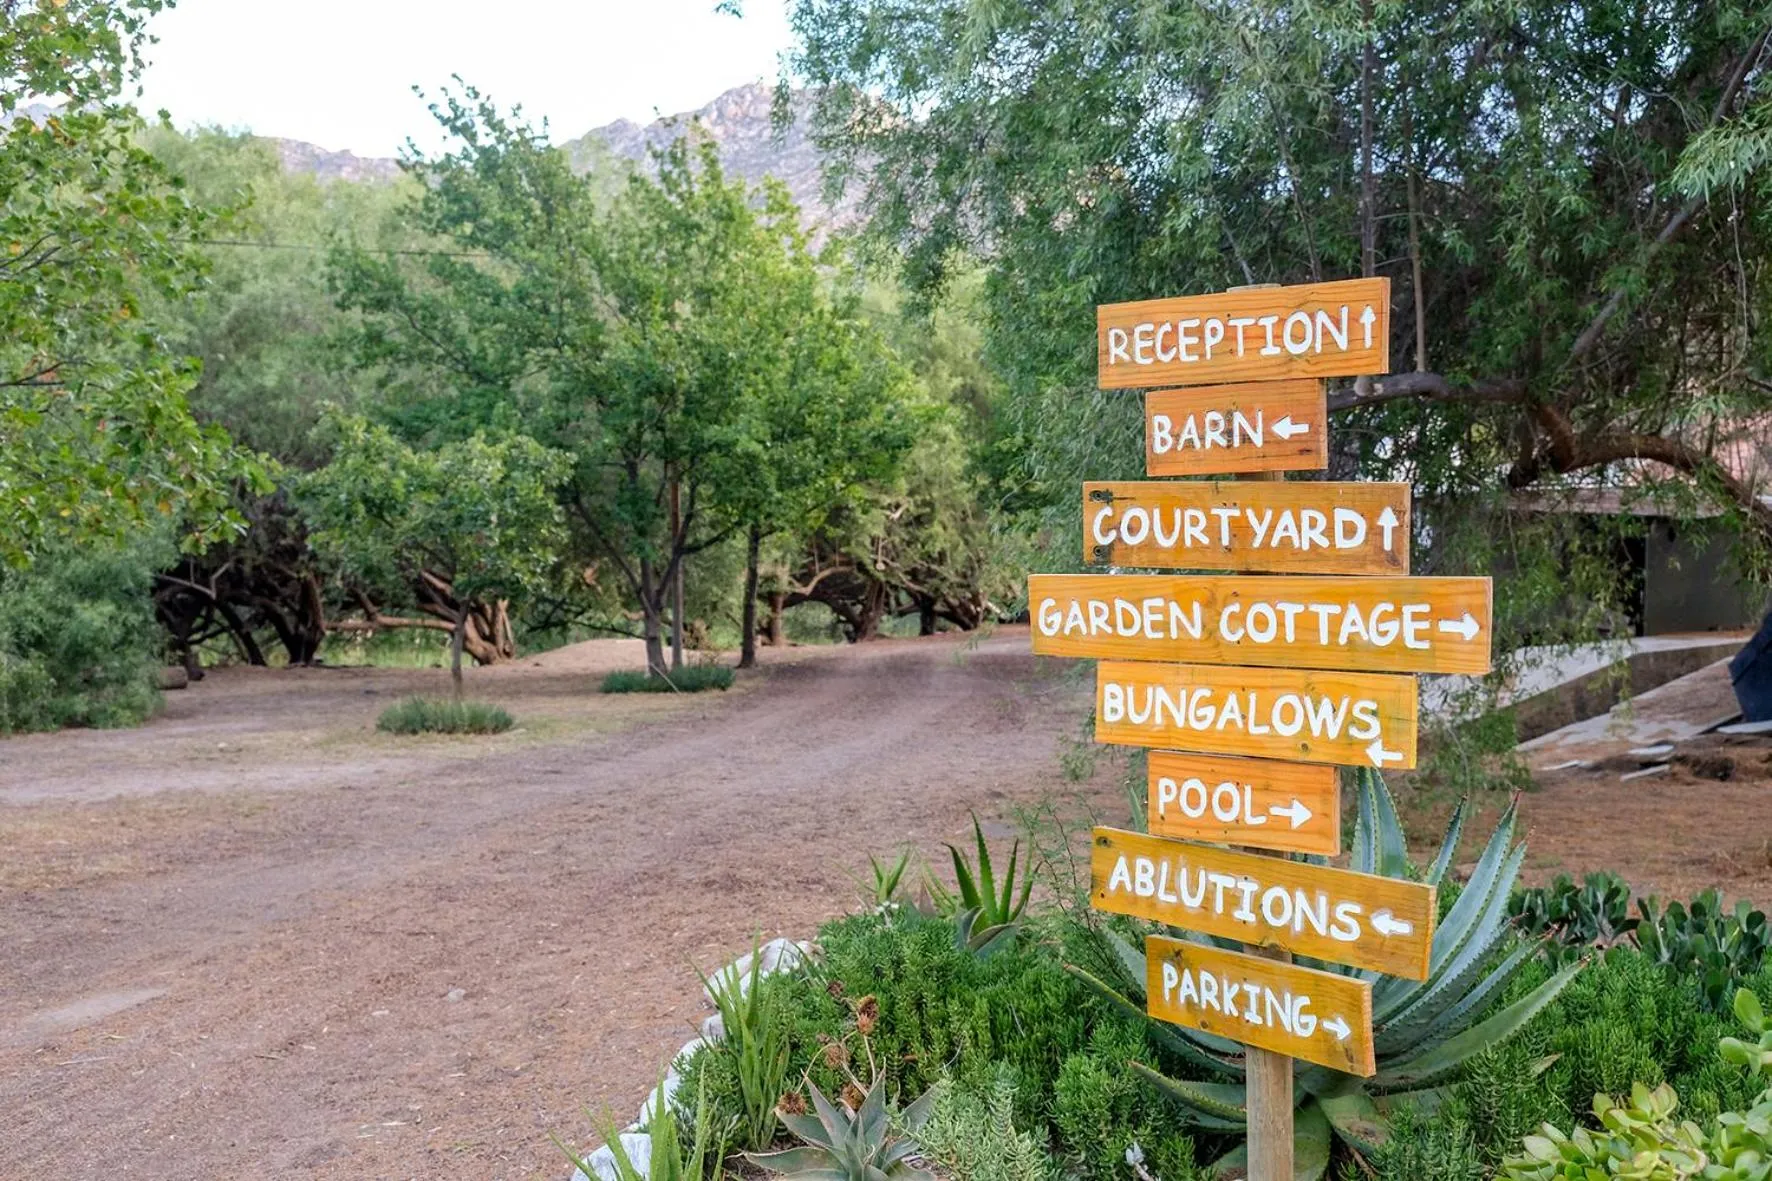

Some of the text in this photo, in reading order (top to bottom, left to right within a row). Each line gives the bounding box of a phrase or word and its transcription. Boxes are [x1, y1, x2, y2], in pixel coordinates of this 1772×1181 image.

[1108, 305, 1350, 364] RECEPTION
[1152, 409, 1264, 454] BARN
[1092, 506, 1367, 551] COURTYARD
[1038, 597, 1431, 649] GARDEN COTTAGE
[1103, 683, 1381, 740] BUNGALOWS
[1158, 777, 1267, 825] POOL
[1109, 856, 1362, 942] ABLUTIONS
[1162, 964, 1317, 1038] PARKING
